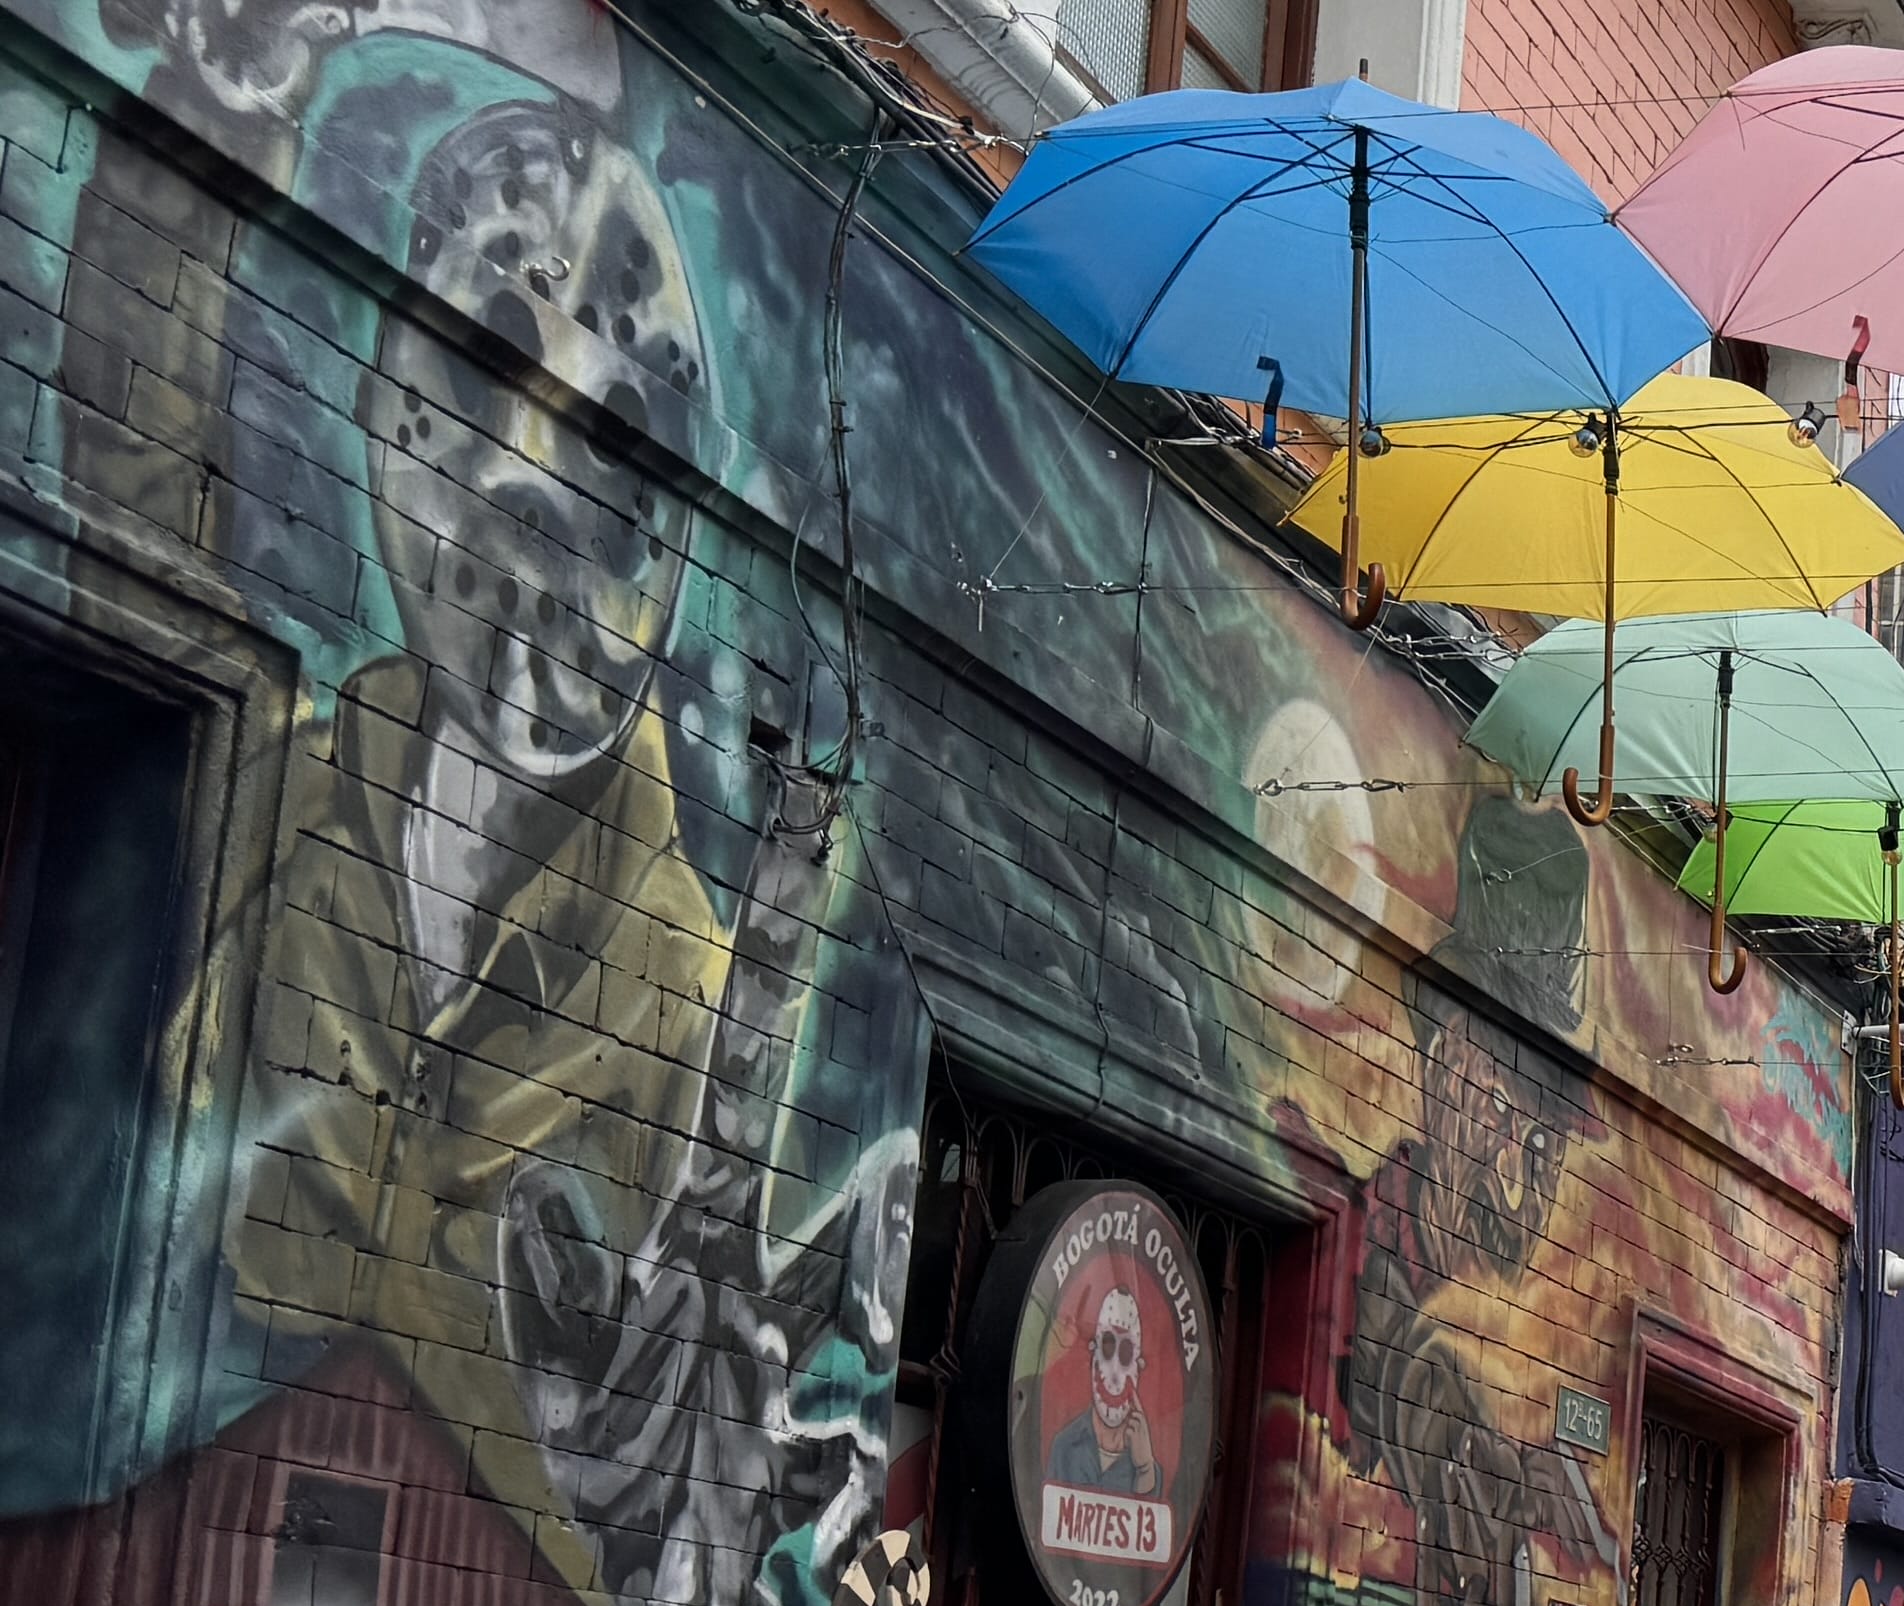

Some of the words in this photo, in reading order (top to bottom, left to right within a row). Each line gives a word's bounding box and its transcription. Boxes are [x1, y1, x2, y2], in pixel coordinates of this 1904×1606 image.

[1051, 1203, 1140, 1289] BOGOTÁ
[1144, 1227, 1200, 1373] OCULTA
[1056, 1492, 1129, 1551] MARTES
[1135, 1506, 1157, 1553] 13
